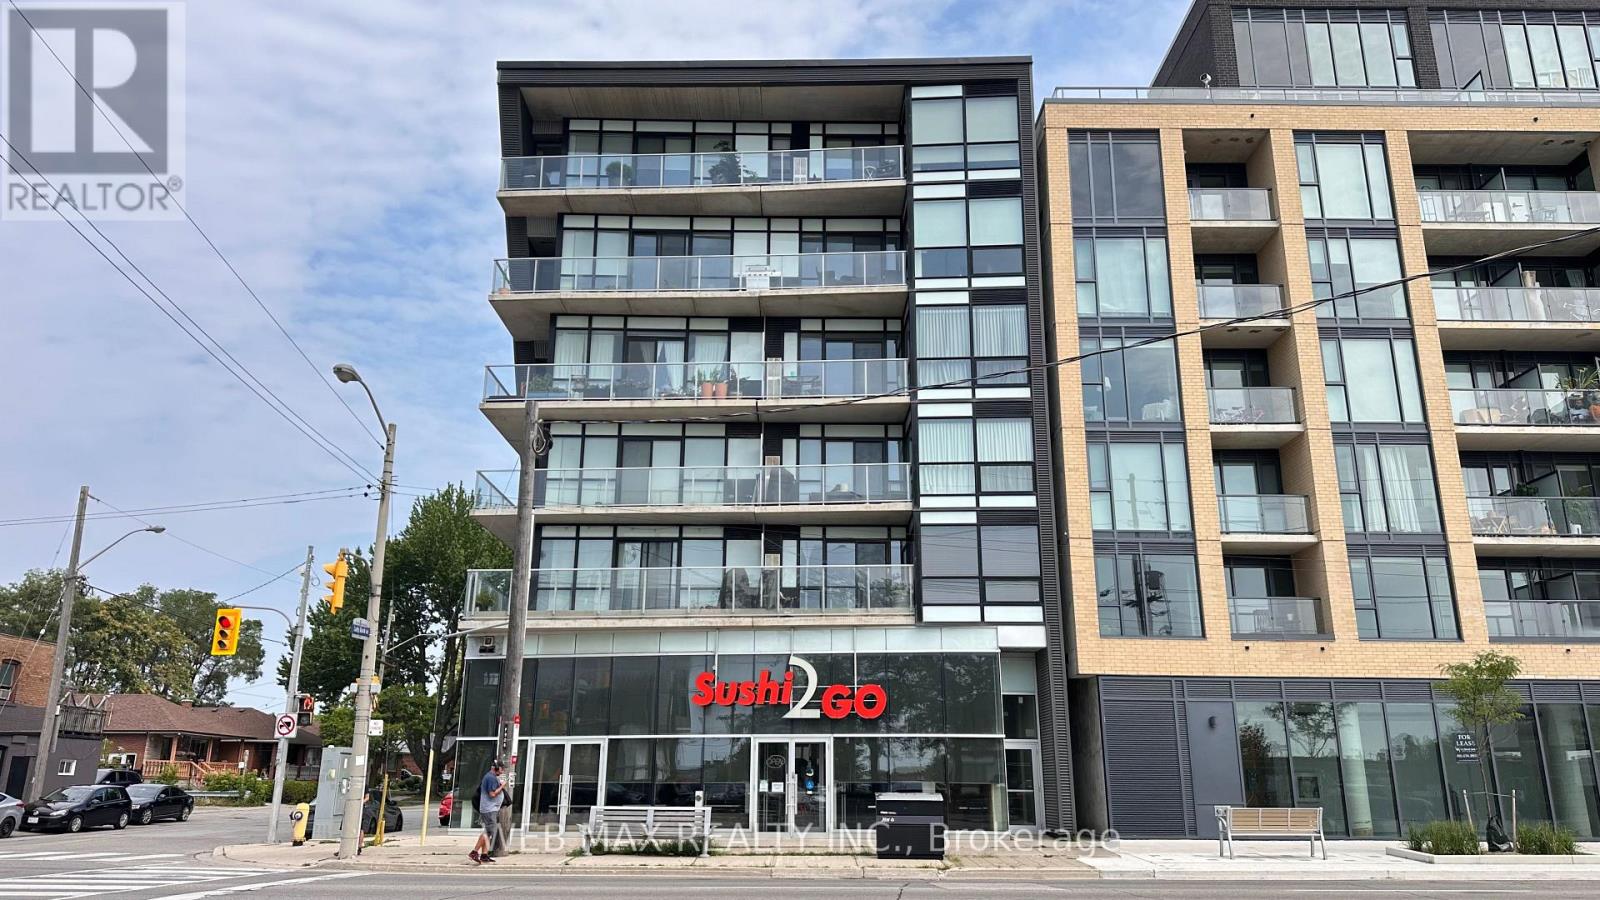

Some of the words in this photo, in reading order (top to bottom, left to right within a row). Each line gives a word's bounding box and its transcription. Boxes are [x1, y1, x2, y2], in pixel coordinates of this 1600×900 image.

[691, 670, 794, 706] Sushi
[781, 655, 821, 719] 2
[821, 684, 887, 720] GO
